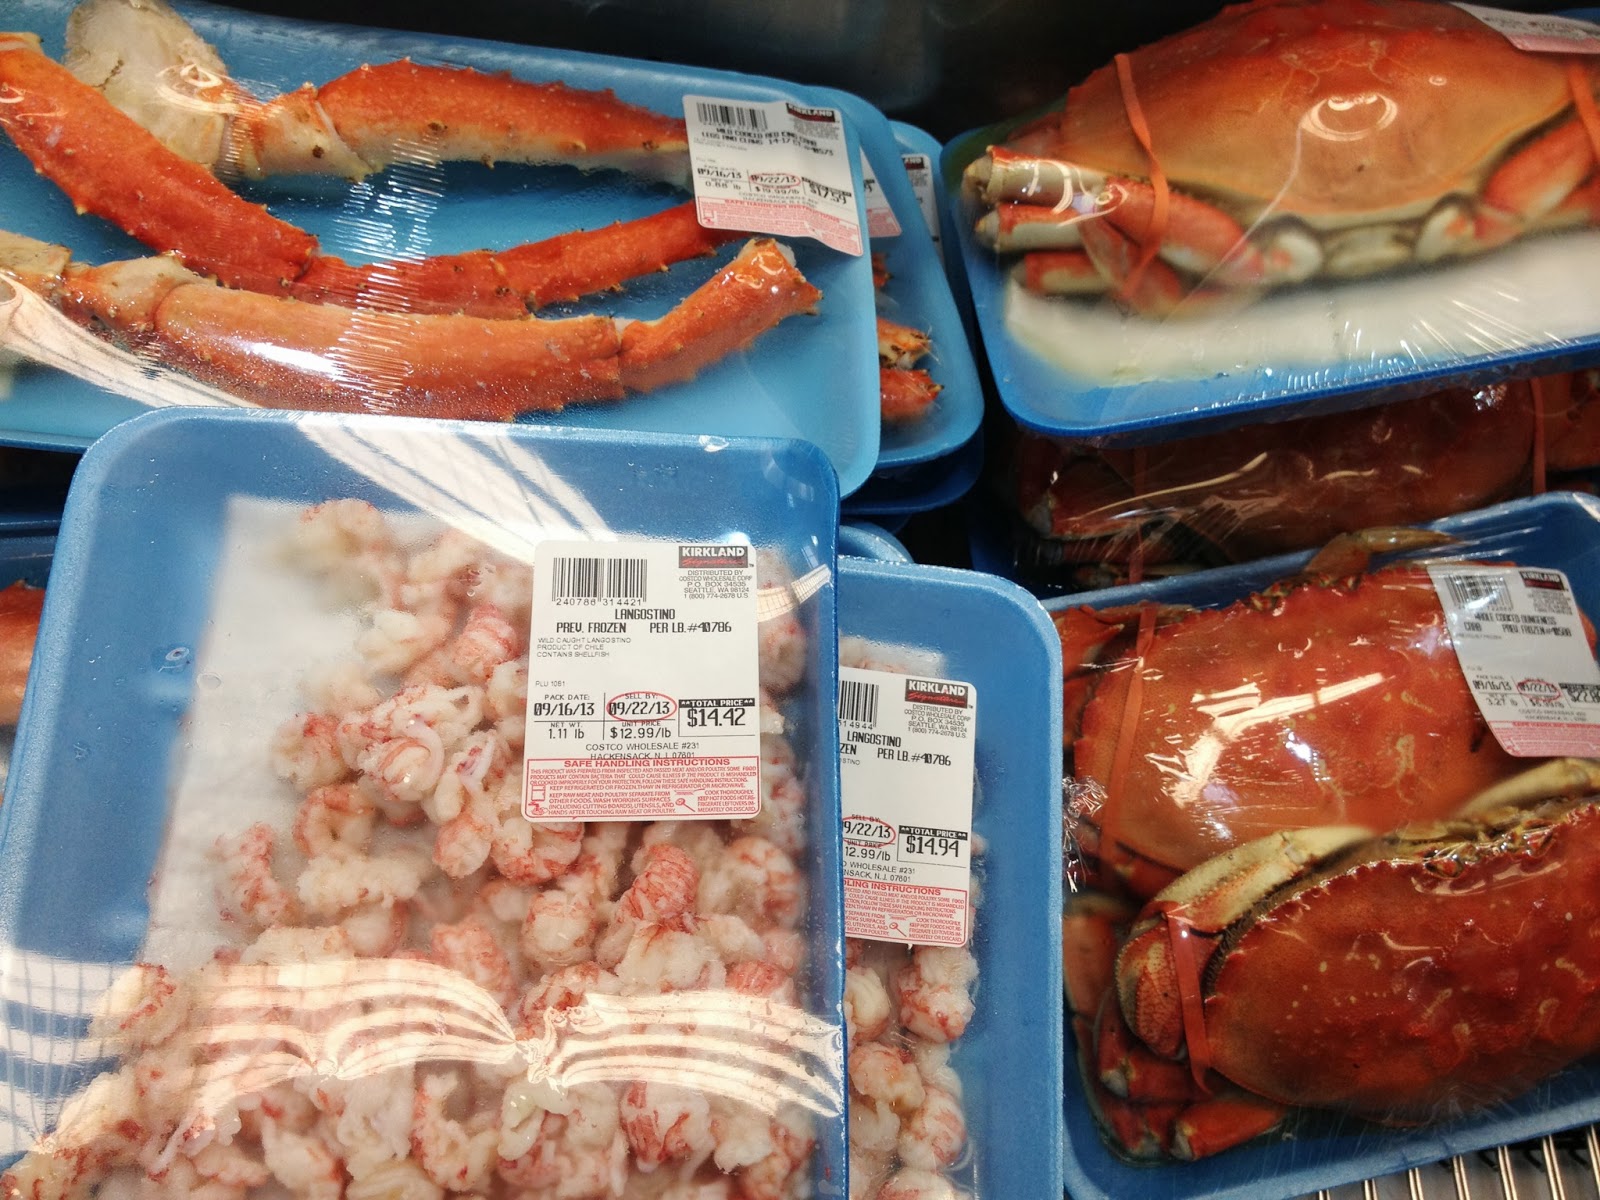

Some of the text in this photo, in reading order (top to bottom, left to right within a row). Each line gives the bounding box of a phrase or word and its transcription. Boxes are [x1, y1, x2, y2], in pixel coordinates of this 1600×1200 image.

[682, 547, 745, 557] KIRKLAND
[556, 598, 642, 606] 240786 314421
[615, 608, 676, 620] LANGOSTINO
[556, 622, 584, 633] PREV.
[588, 622, 627, 633] FROZEN
[649, 622, 669, 633] PER
[908, 680, 966, 697] KIRKLAND
[533, 702, 595, 716] 09/16/13
[608, 701, 670, 716] 09/22/13
[904, 708, 925, 716] COSTCO
[925, 711, 956, 720] WHOLESALE
[912, 703, 953, 714] DISTRIBUTED
[686, 707, 746, 728] $14.42
[944, 719, 965, 727] 34535
[548, 728, 585, 739] 1.11 lb
[609, 726, 672, 739] $12.99/lb
[949, 725, 967, 733] 98124
[847, 730, 902, 748] LANGOSTINO
[585, 742, 700, 751] COSTCO WHOLESALE #231
[840, 742, 857, 755] ZEN
[877, 747, 894, 760] PER
[564, 758, 731, 768] SAFE HANDLING INSTRUCTIONS
[851, 813, 865, 821] SELL
[843, 820, 891, 839] 9/22/13
[906, 835, 959, 858] $14.94
[844, 846, 891, 862] 12.99/lb
[843, 868, 873, 880] NSACK,
[849, 861, 916, 875] WHOLESALE #231
[844, 878, 942, 896] LING INSTRUCTIONS
